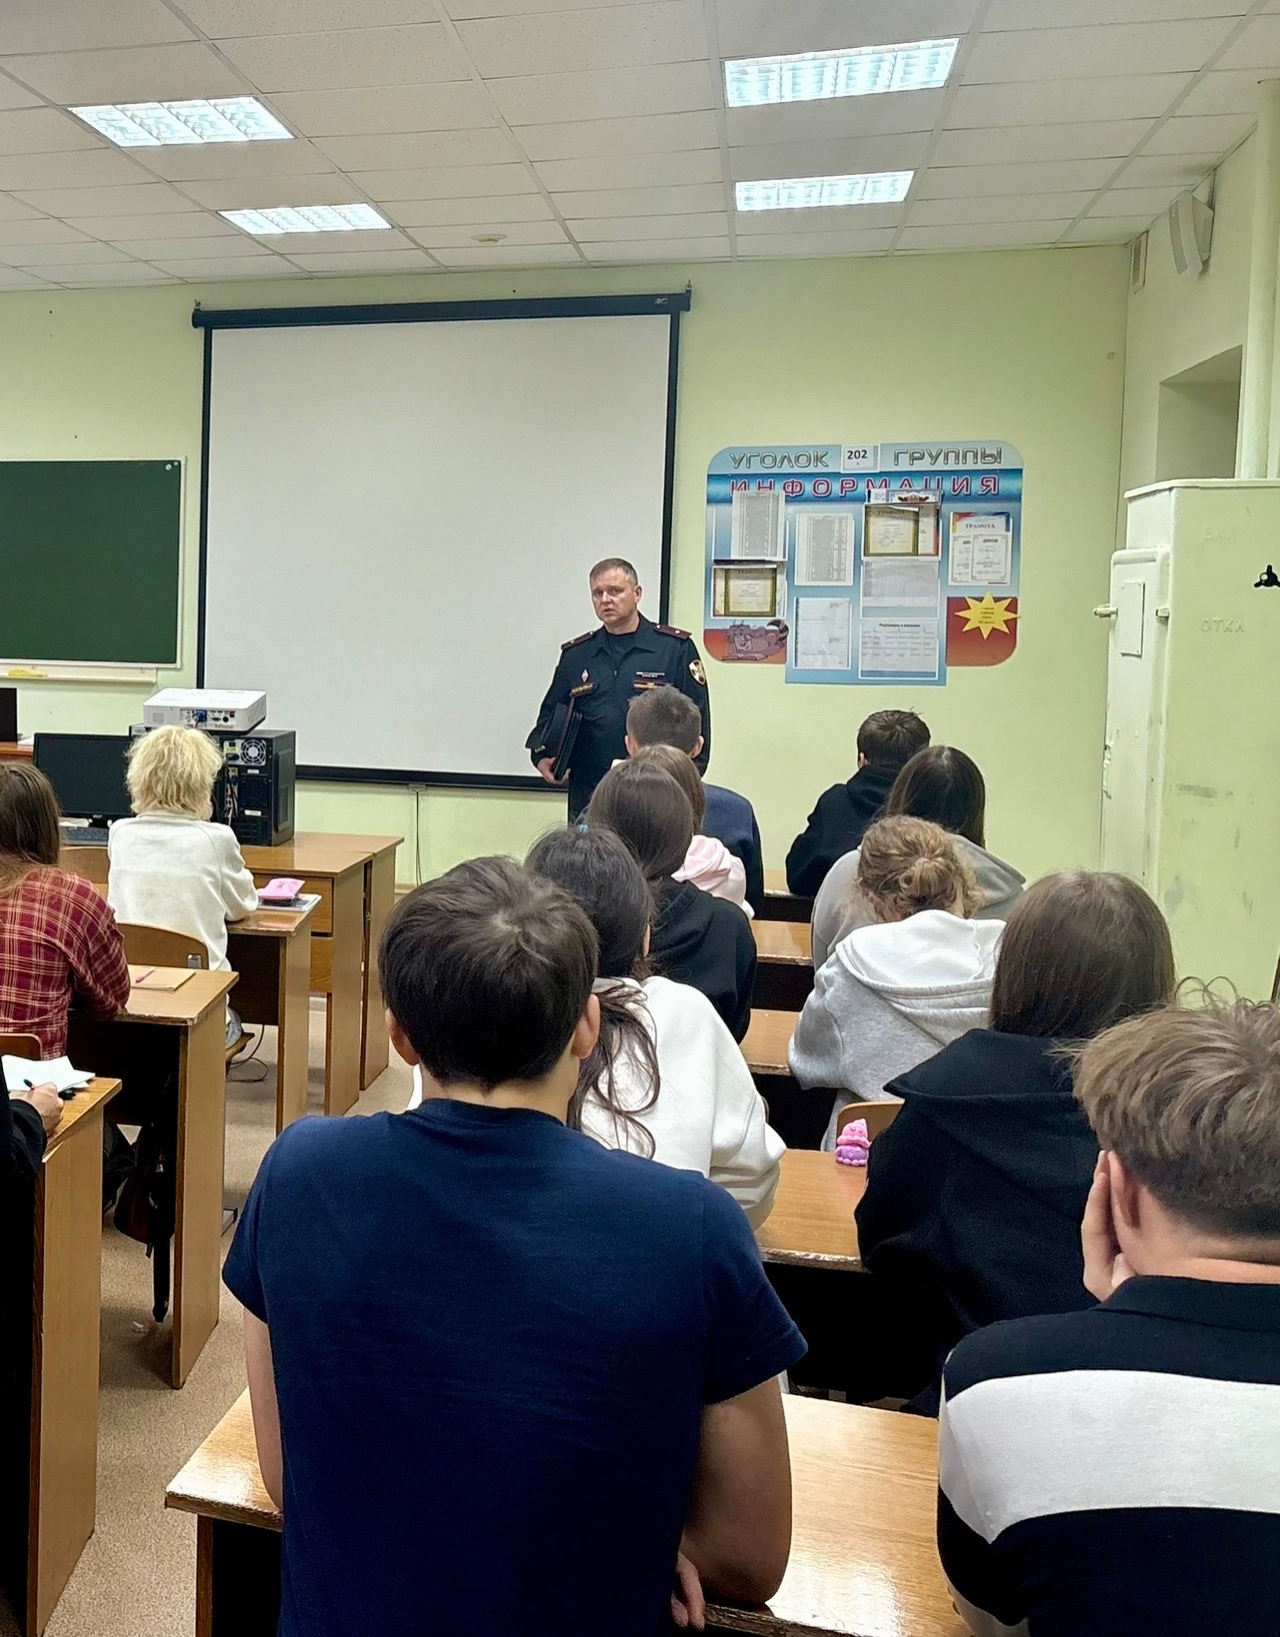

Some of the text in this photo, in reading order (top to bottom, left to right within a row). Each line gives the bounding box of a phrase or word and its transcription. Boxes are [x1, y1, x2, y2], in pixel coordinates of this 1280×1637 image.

[729, 447, 1002, 469] УГОЛОК 202 ГРУППЫ
[729, 475, 999, 497] ИНФОРМАЦИЯ
